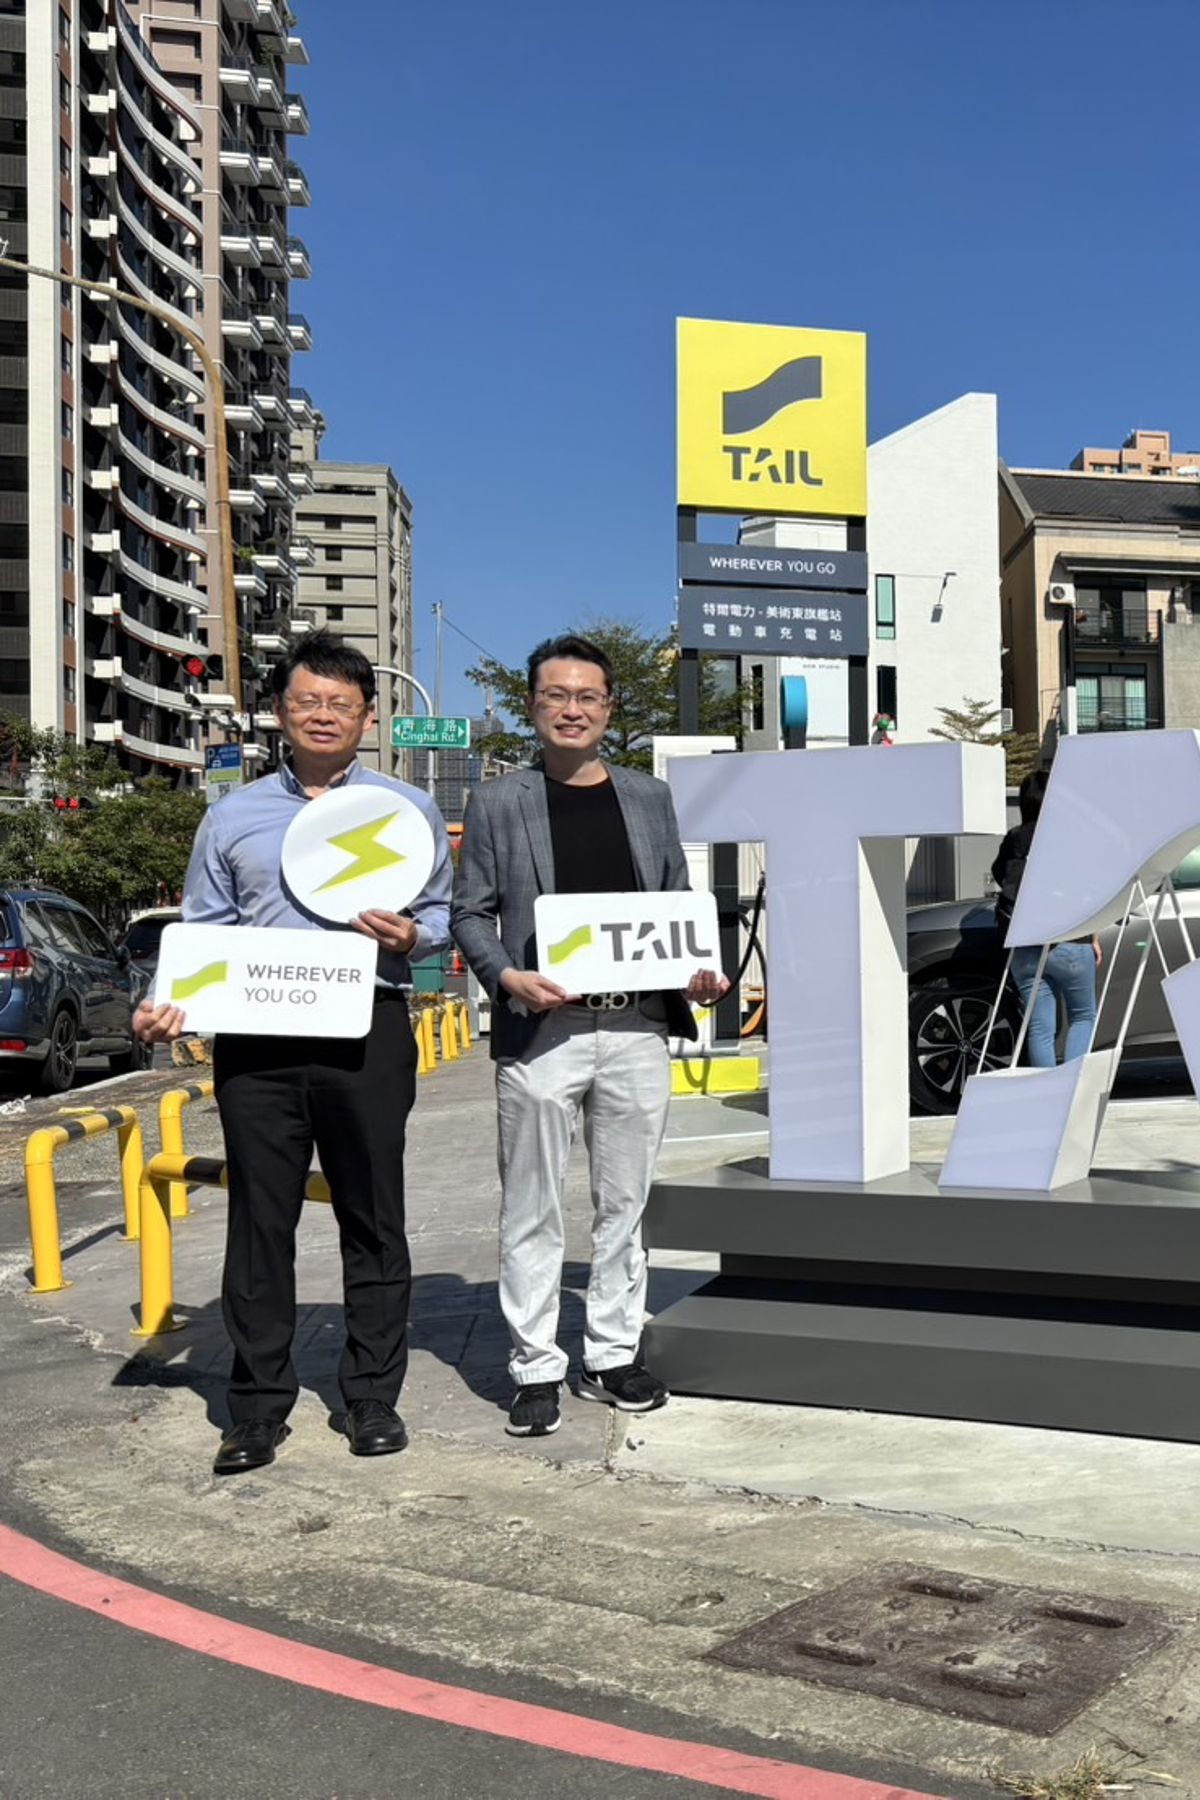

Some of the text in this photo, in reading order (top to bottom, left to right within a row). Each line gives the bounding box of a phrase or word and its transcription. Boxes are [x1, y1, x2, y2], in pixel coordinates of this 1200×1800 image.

[722, 445, 823, 486] TAIL
[709, 556, 837, 575] WHEREVER YOU GO
[441, 732, 457, 742] Rd.
[600, 920, 713, 962] TAIL
[246, 963, 362, 984] WHEREVER
[244, 987, 317, 1005] YOU GO
